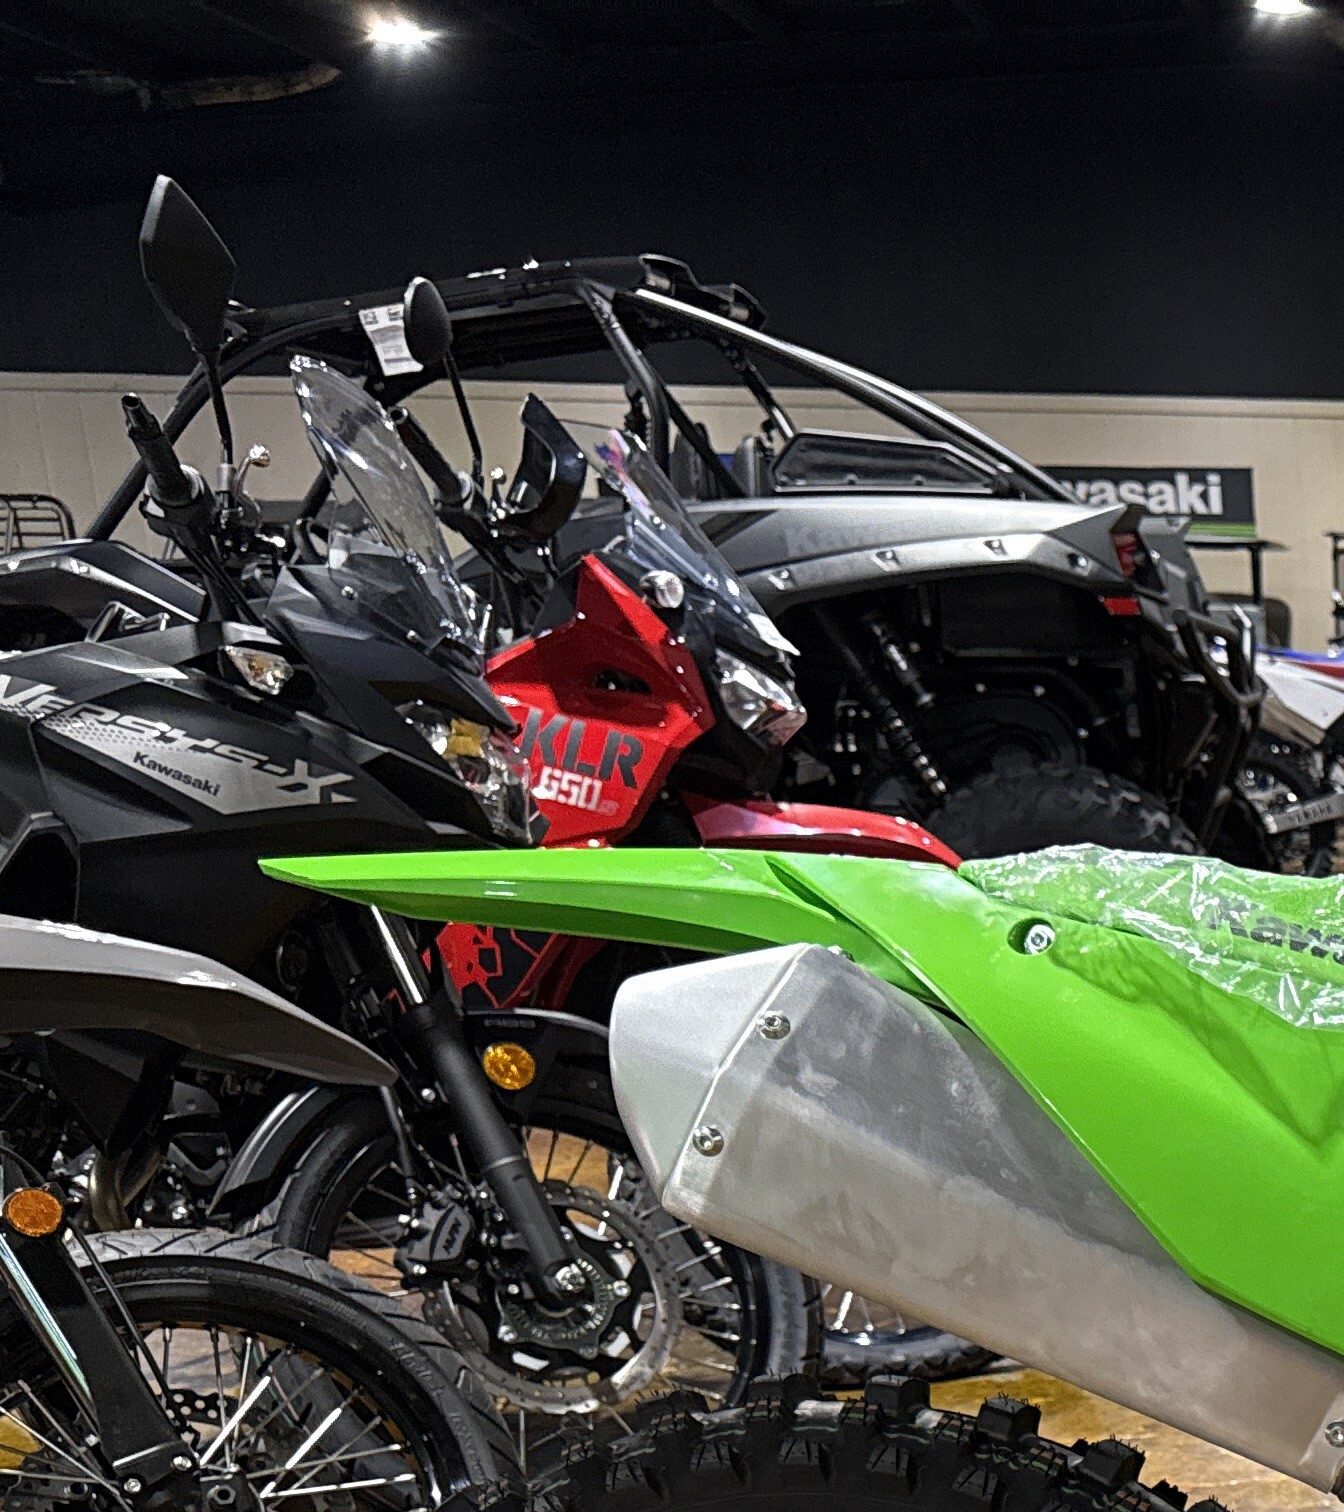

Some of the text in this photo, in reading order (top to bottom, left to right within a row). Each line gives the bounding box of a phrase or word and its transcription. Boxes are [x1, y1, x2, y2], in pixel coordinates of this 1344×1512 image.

[519, 707, 644, 790] KLR
[132, 750, 222, 798] Kawasaki
[531, 765, 603, 811] 650
